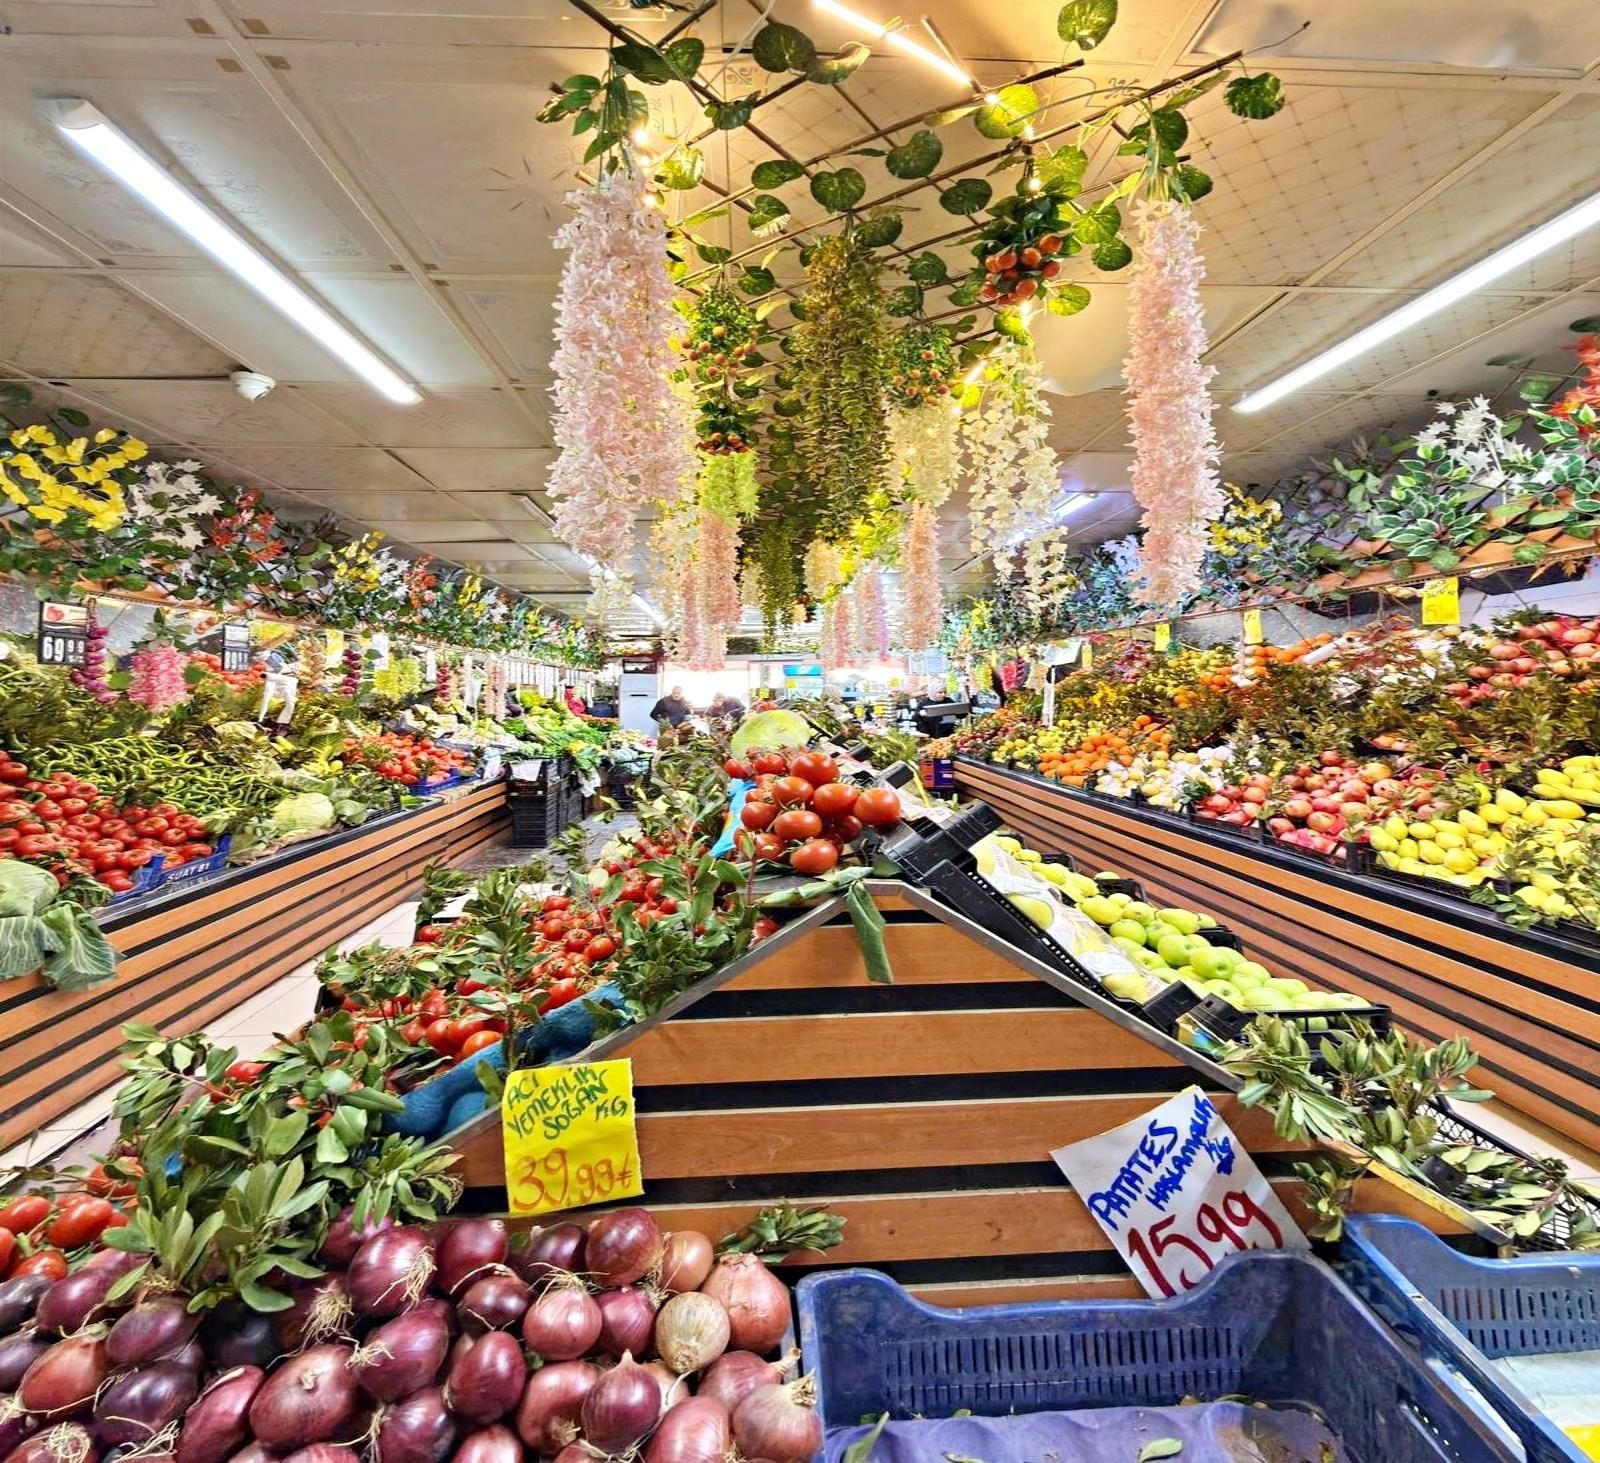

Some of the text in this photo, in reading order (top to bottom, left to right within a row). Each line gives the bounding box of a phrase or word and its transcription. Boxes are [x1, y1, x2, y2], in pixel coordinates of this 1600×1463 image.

[43, 636, 64, 662] 69
[507, 1072, 540, 1110] ACI
[594, 1096, 628, 1122] KG
[1087, 1118, 1178, 1231] PATATES
